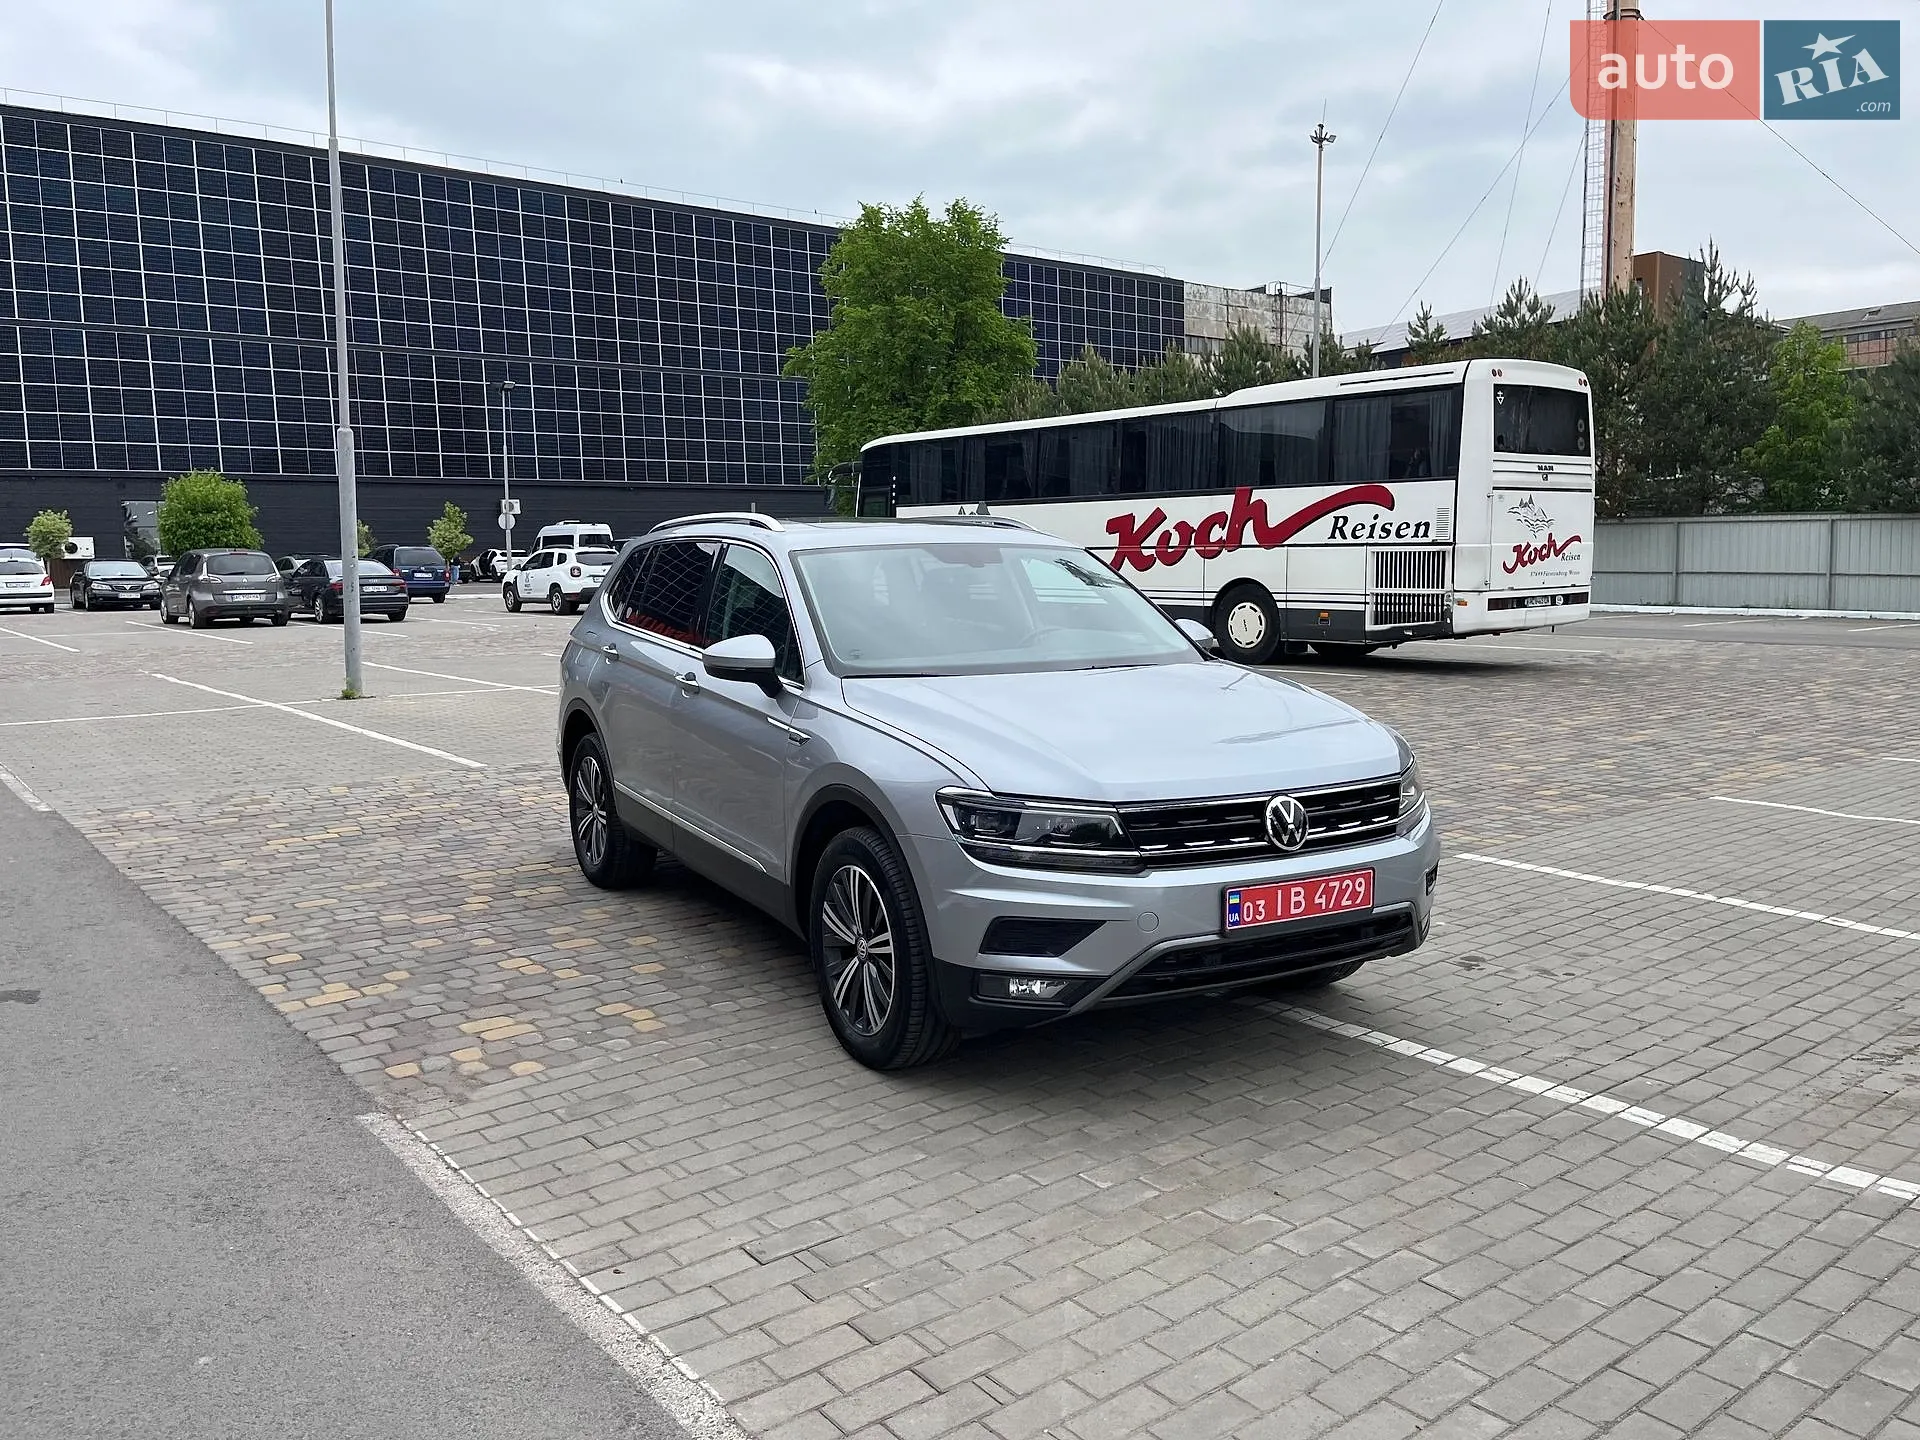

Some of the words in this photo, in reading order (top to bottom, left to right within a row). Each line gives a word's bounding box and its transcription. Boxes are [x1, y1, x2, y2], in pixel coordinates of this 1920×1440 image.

[1105, 485, 1395, 572] Koch
[1327, 513, 1431, 541] Reisen
[1502, 532, 1582, 574] Koch
[1560, 552, 1581, 562] Reisen
[1228, 913, 1240, 922] UA
[1243, 899, 1266, 922] 03
[1314, 877, 1366, 910] 4729
